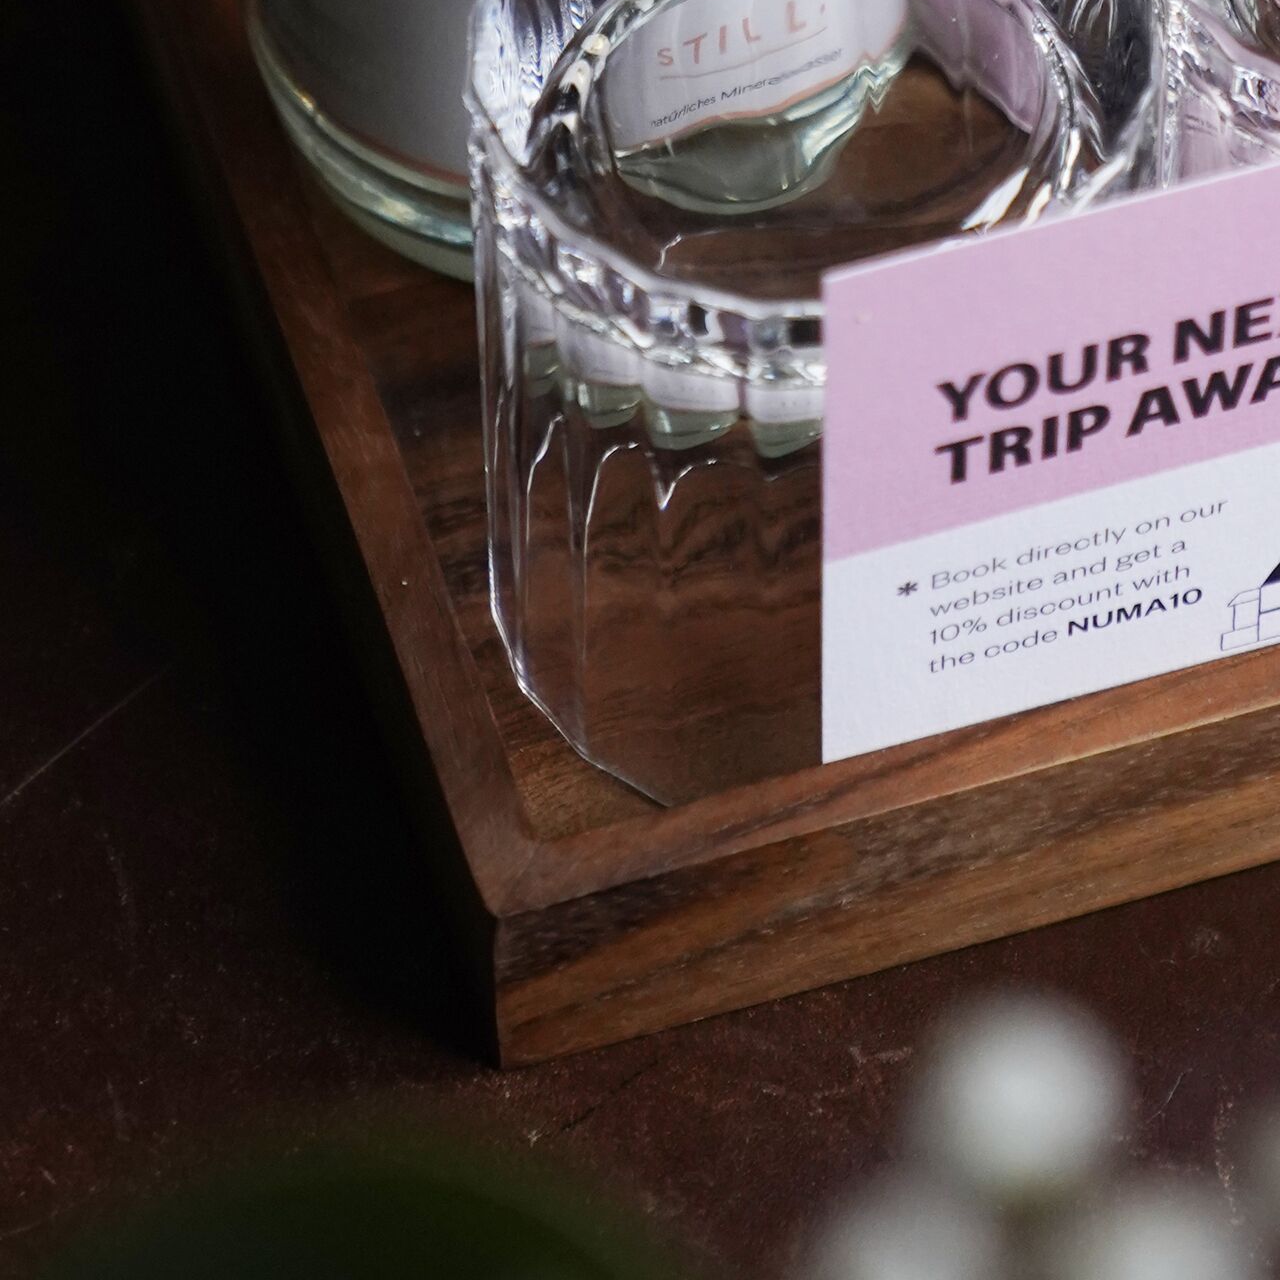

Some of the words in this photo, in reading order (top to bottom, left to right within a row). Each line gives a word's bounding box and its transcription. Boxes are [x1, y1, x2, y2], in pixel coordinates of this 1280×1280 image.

[936, 332, 1151, 423] YOUR
[934, 404, 1111, 485] TRIP
[929, 575, 1043, 617] website
[1053, 557, 1107, 585] and
[1115, 544, 1161, 572] get
[1171, 539, 1187, 554] a
[930, 557, 1008, 590] Book
[1016, 528, 1126, 567] directly
[1135, 516, 1171, 536] on
[1179, 499, 1229, 522] our
[929, 617, 988, 645] 10%
[996, 583, 1123, 627] discount
[1132, 565, 1190, 592] with
[929, 650, 975, 674] the
[984, 629, 1058, 658] code
[1067, 587, 1203, 637] NUMA10
